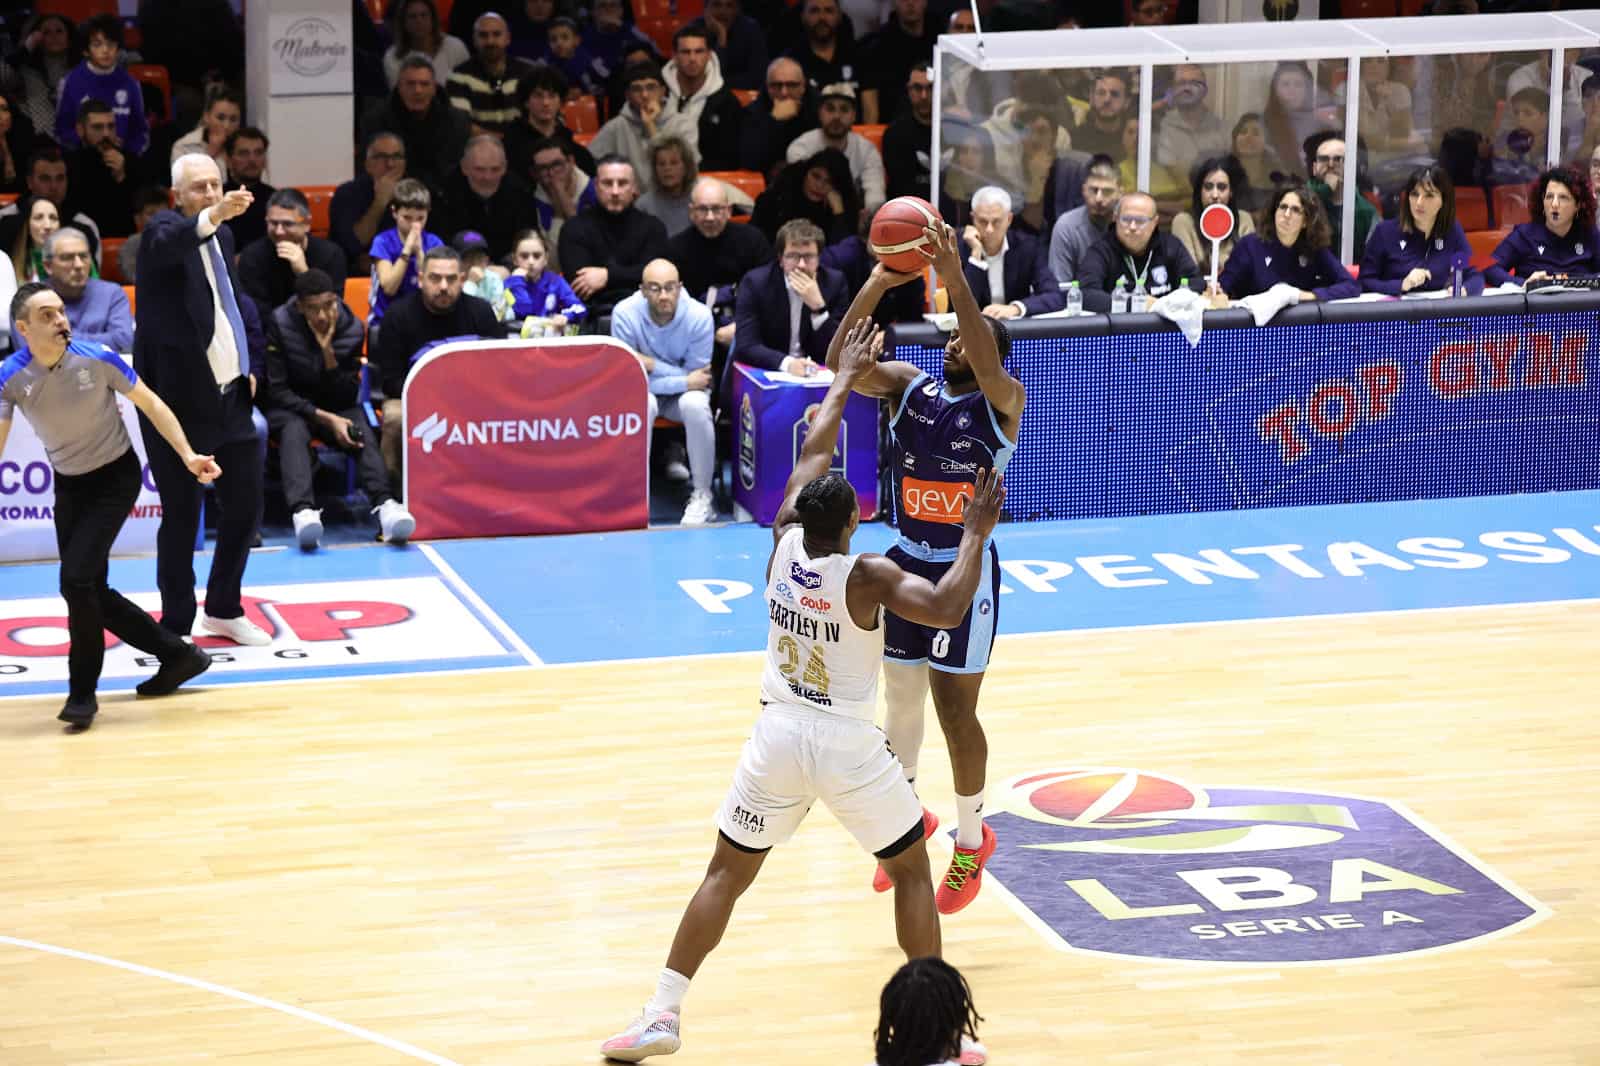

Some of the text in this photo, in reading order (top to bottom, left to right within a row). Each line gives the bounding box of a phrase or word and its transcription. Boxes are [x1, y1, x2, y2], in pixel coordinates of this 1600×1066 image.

[1258, 332, 1588, 463] TOP GYM
[446, 412, 643, 446] ANTENNA SUD
[905, 484, 967, 517] gevi
[999, 527, 1600, 595] PENTASS
[824, 621, 841, 643] IV
[931, 629, 951, 659] 0
[734, 804, 766, 827] ATTAL
[1064, 857, 1465, 921] LBA
[1189, 910, 1425, 941] SERIE A
